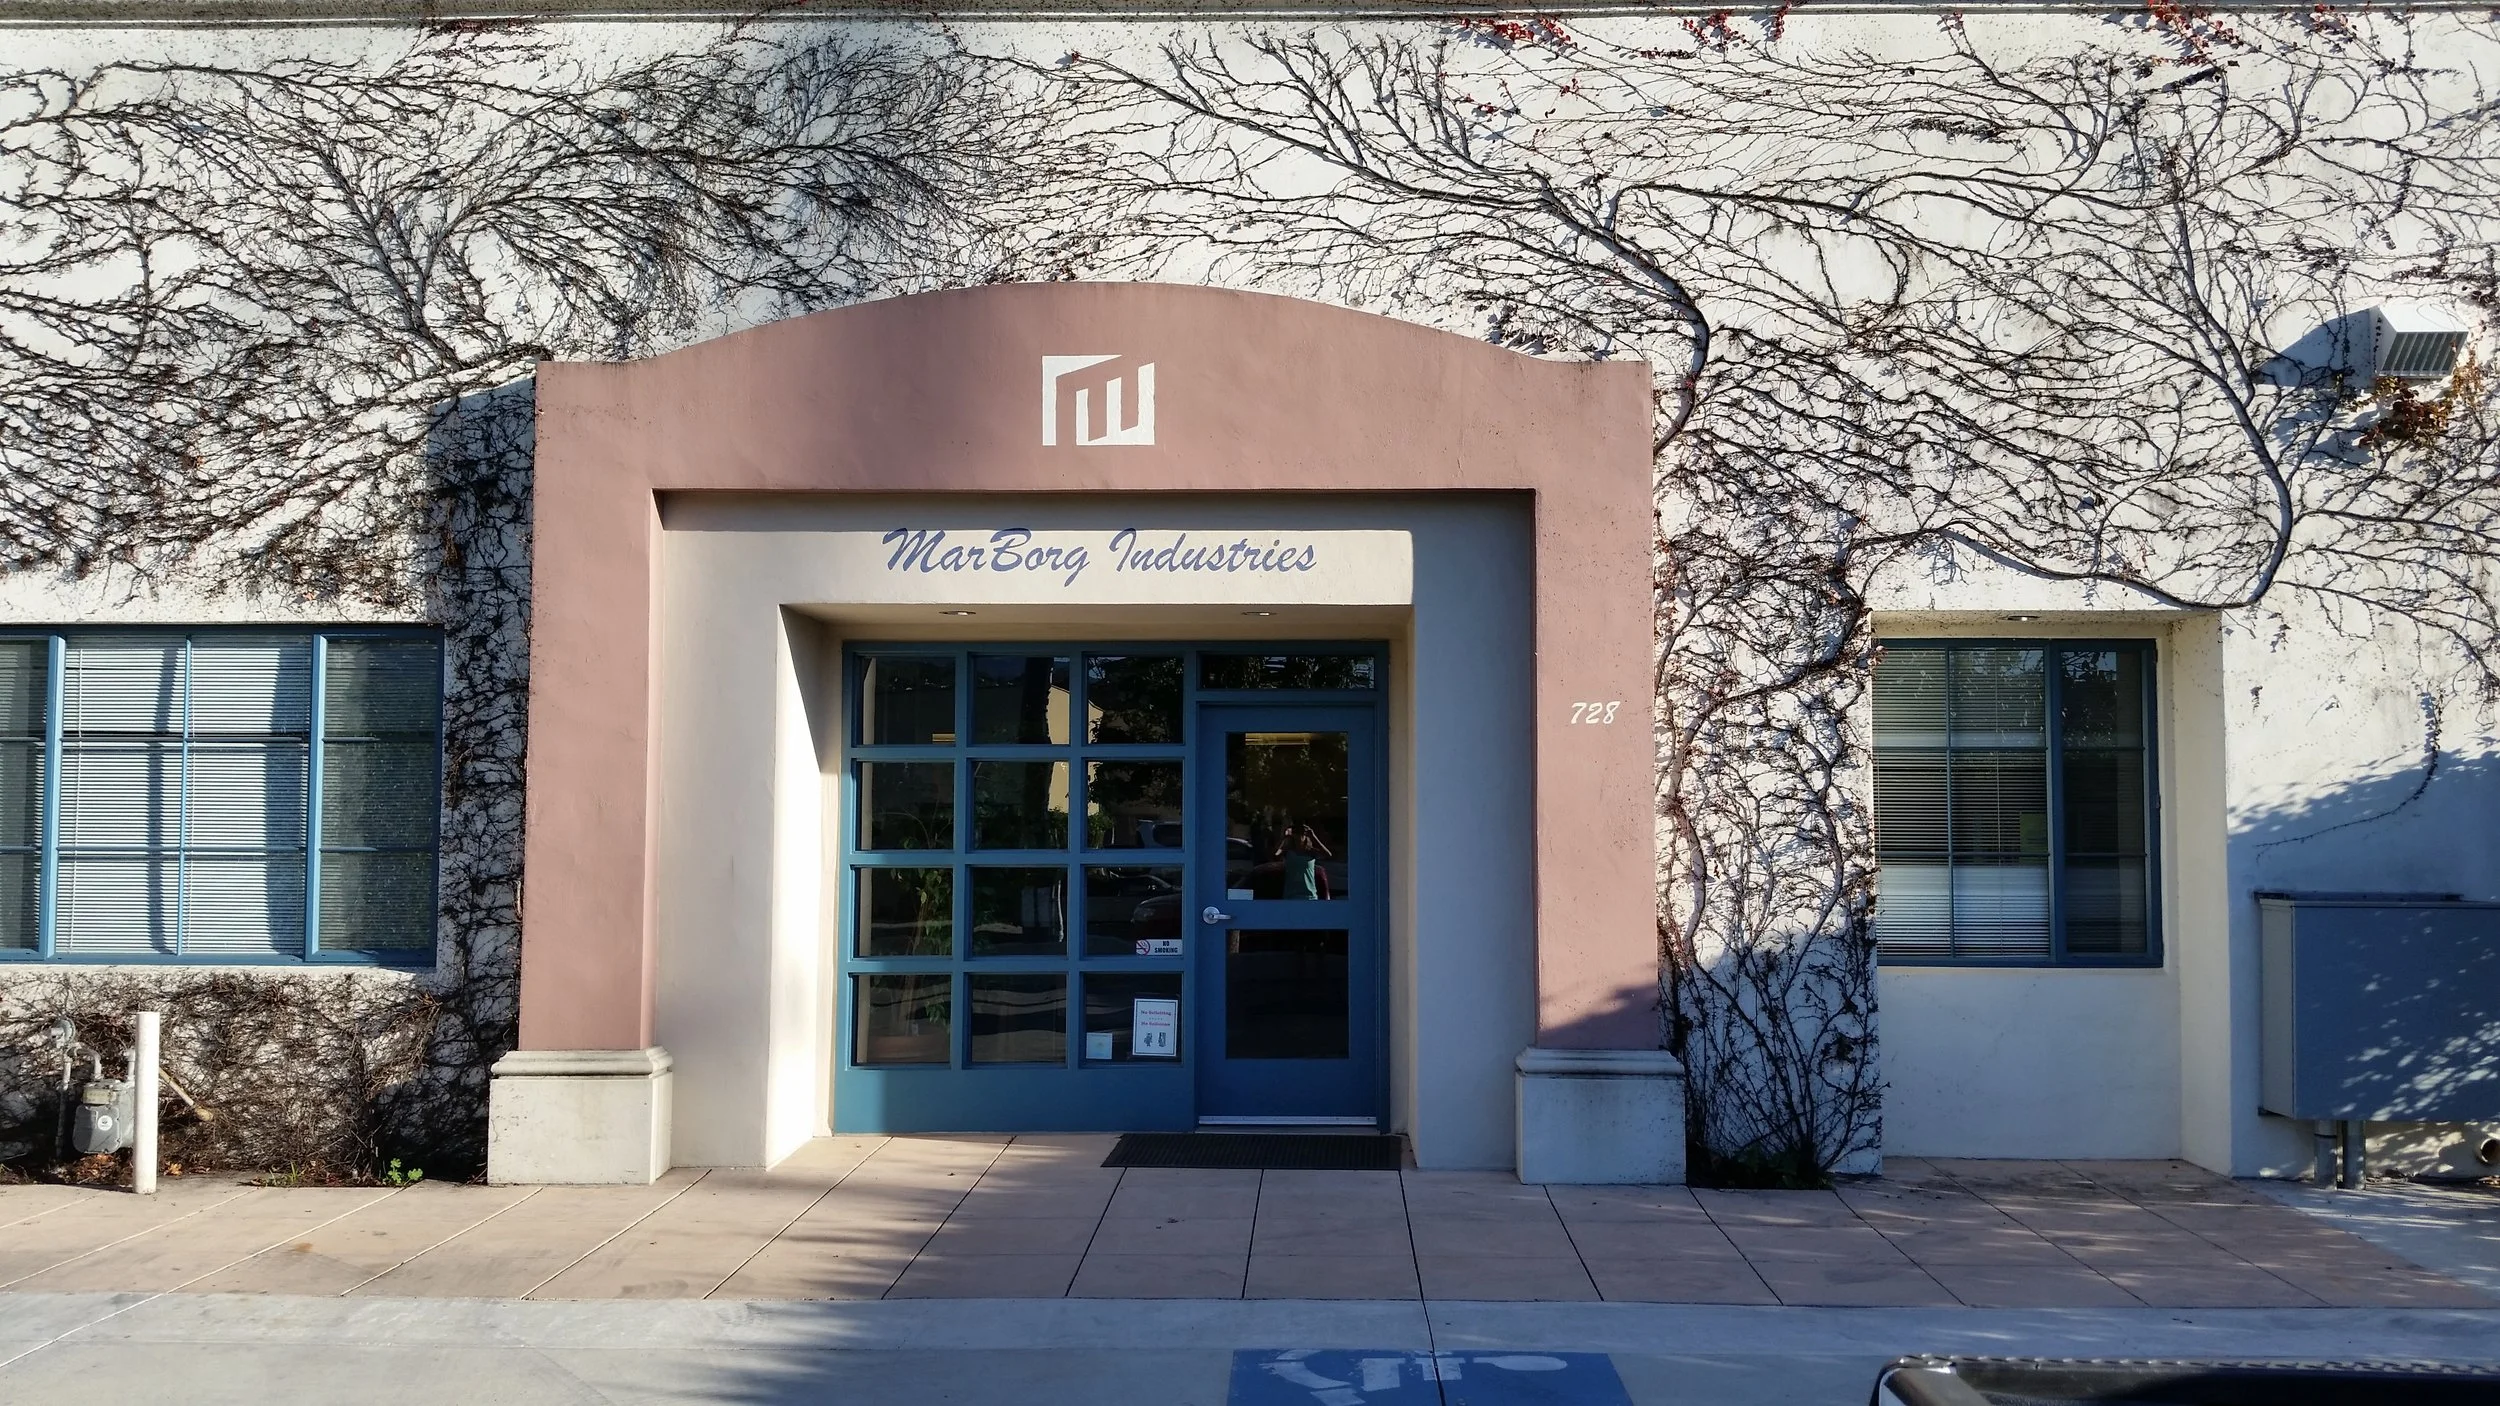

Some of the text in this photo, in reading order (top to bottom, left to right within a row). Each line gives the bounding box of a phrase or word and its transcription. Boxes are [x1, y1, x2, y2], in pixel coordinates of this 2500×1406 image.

[882, 527, 1317, 587] MarBorg Industries
[1571, 701, 1620, 724] 728
